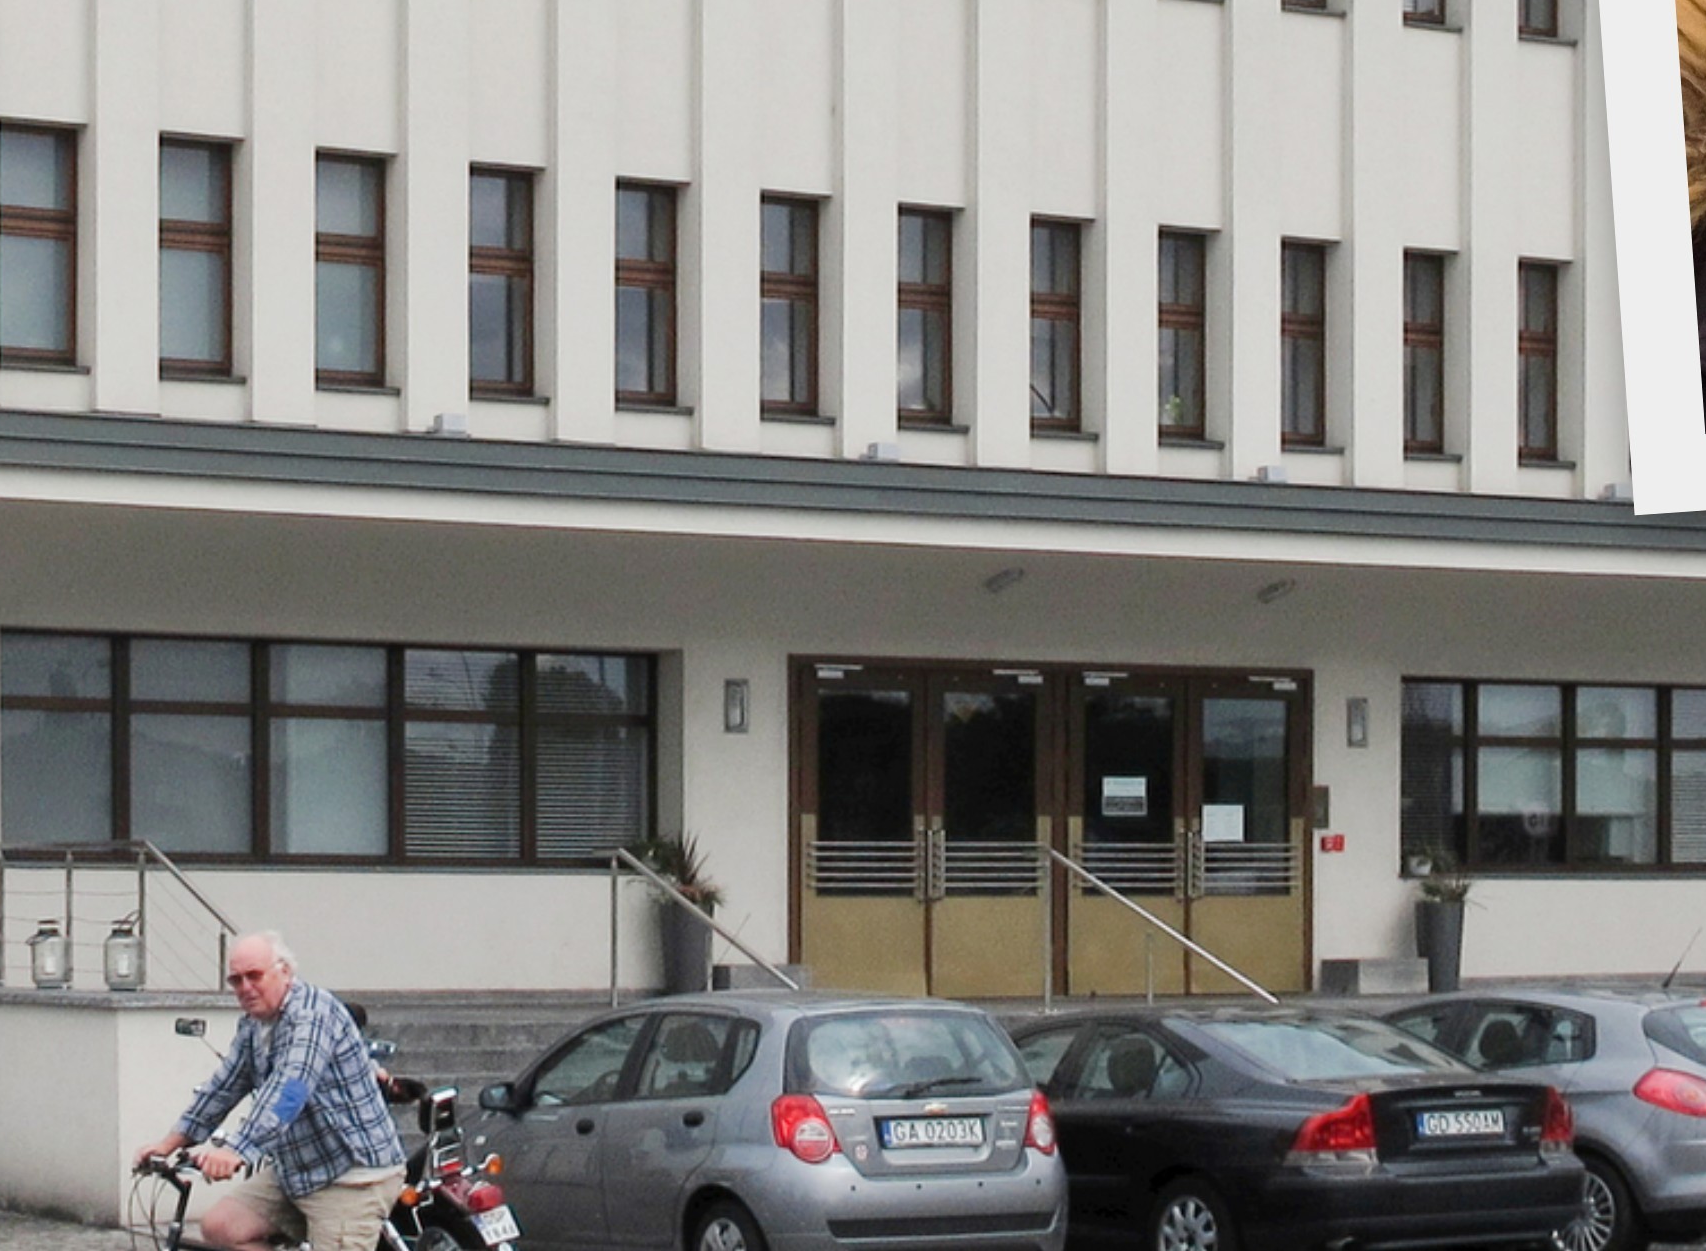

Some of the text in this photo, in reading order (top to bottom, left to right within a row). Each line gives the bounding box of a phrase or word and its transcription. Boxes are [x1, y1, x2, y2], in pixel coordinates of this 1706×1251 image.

[895, 1119, 980, 1142] GA 0203K
[1428, 1111, 1502, 1133] GD 550AM
